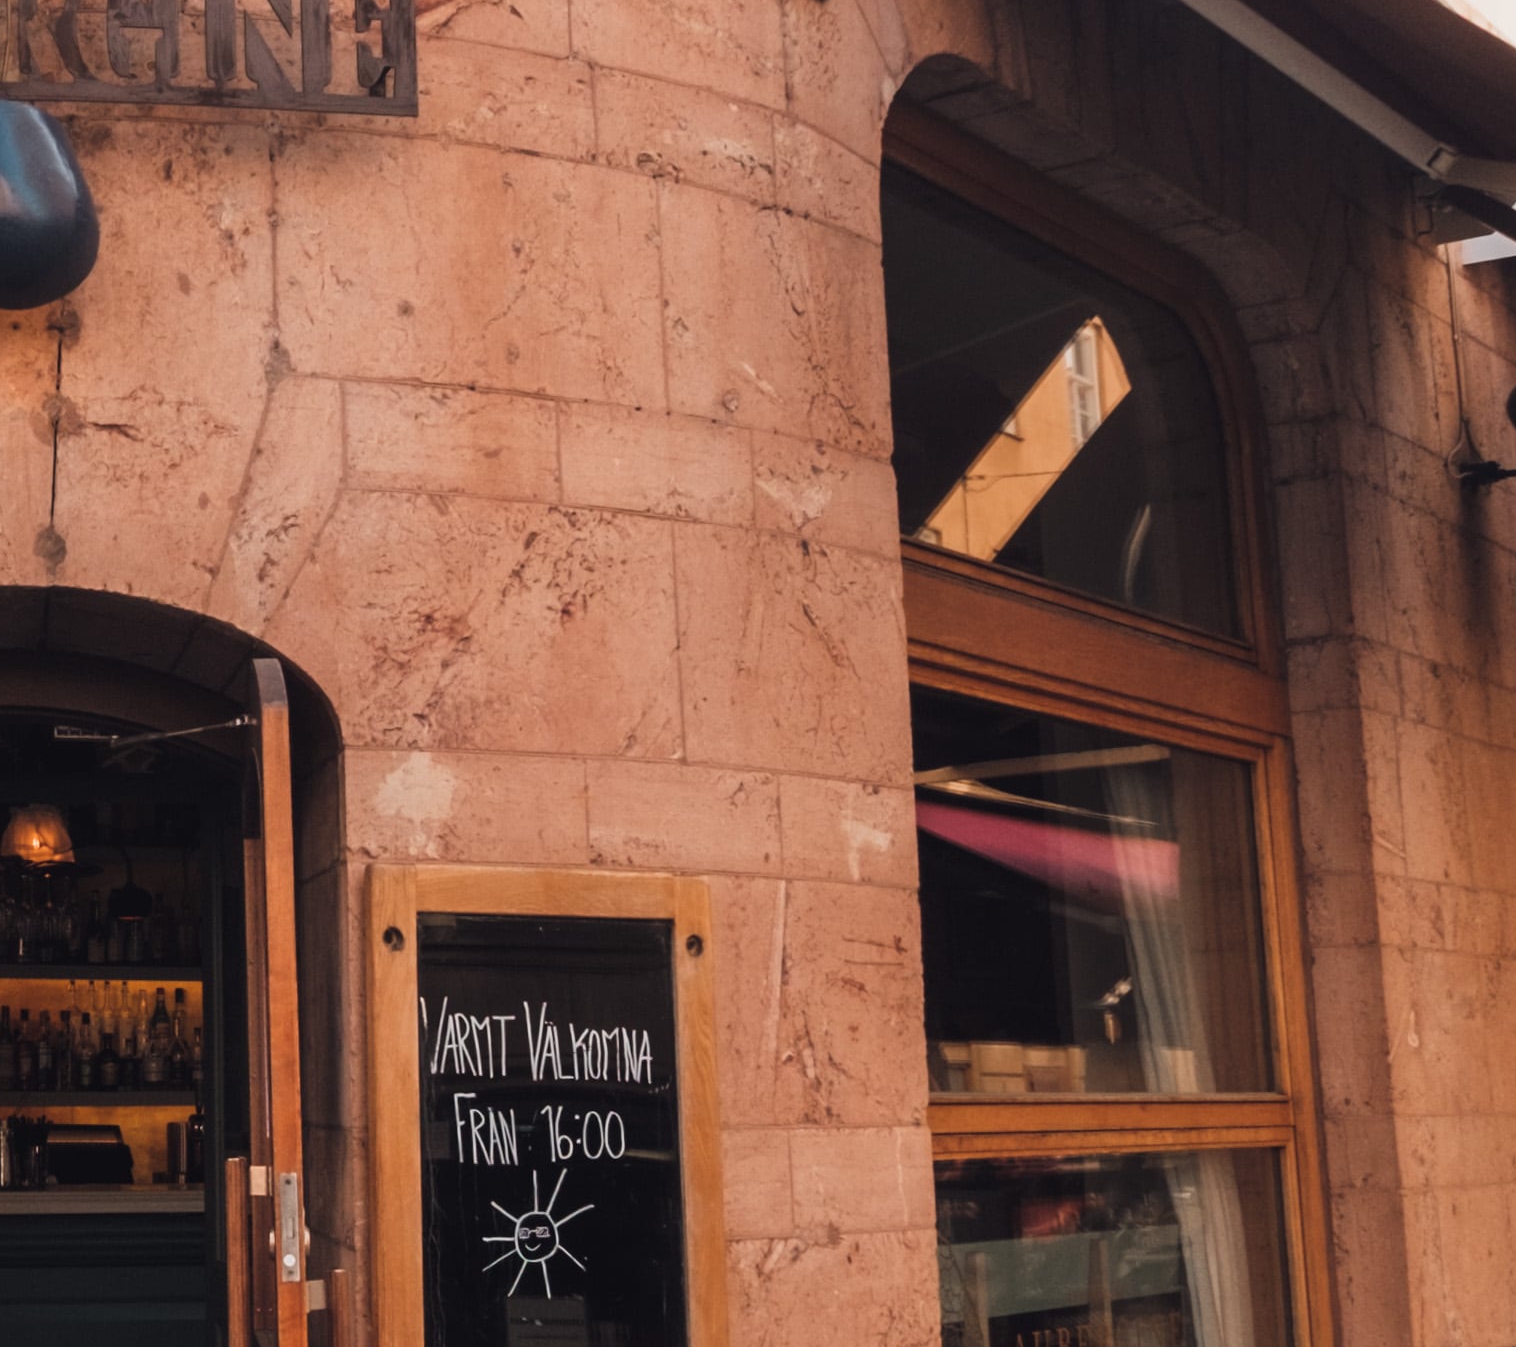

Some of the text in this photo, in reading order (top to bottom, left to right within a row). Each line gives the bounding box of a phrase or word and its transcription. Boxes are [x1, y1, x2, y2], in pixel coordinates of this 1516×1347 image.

[420, 996, 653, 1084] VARMT VÄLKOMNA
[541, 1105, 626, 1163] 16:00
